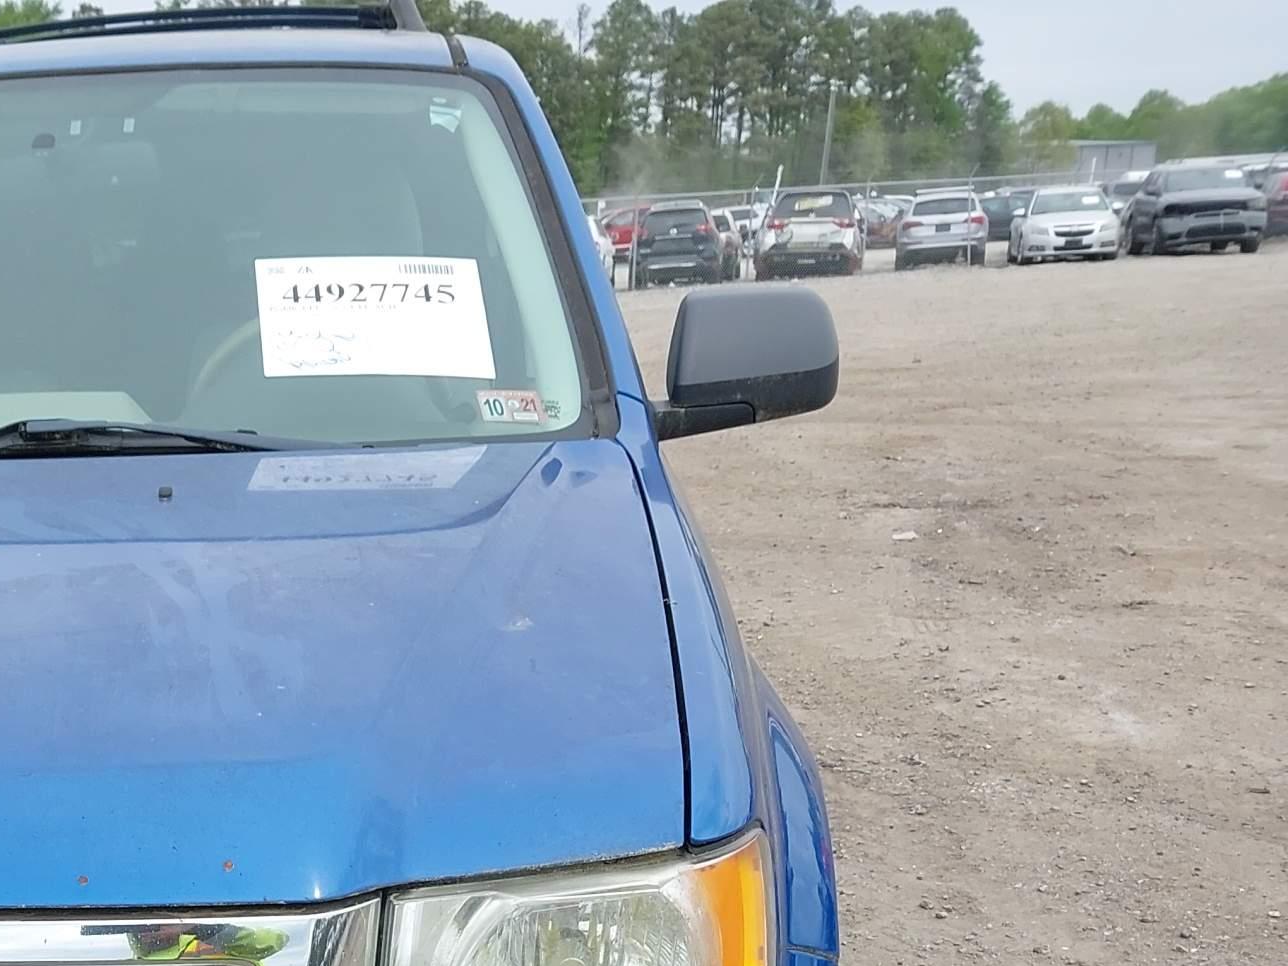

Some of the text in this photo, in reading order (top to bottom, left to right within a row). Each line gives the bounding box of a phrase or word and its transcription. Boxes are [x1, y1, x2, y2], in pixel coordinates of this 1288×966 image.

[282, 283, 455, 304] 44927745
[483, 398, 505, 416] 10
[520, 398, 537, 412] 21
